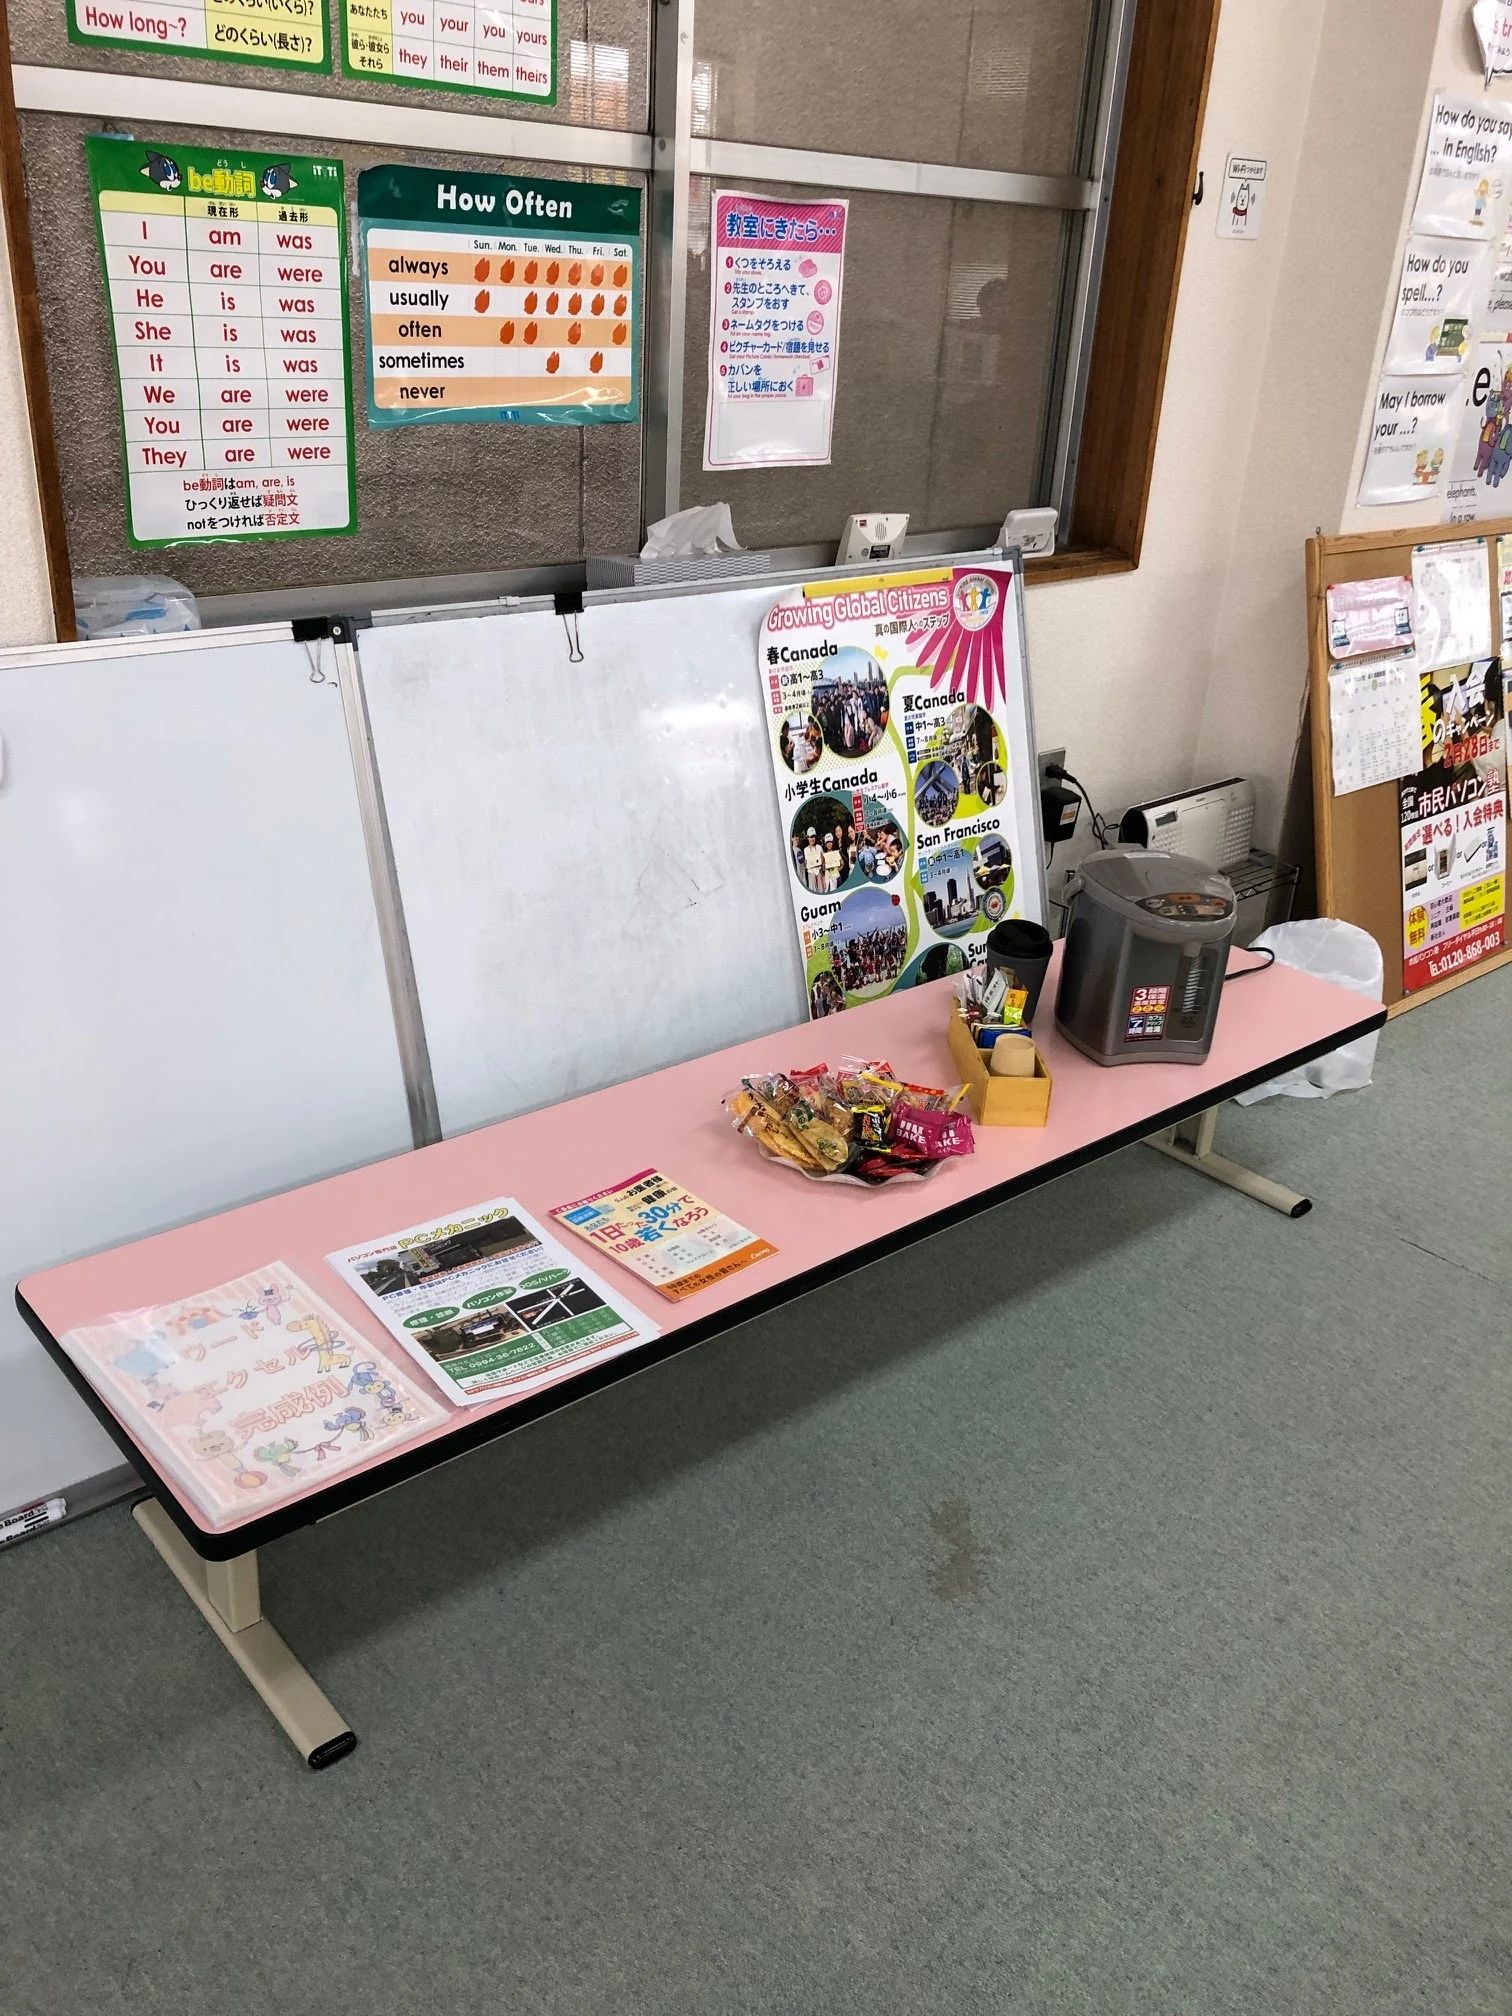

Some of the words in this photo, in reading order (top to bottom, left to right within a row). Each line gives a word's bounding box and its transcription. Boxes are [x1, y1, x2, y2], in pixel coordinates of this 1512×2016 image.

[85, 6, 124, 29] How
[350, 3, 388, 20] あなたたち
[400, 10, 425, 26] you
[440, 17, 469, 32] your
[483, 24, 506, 39] you
[516, 30, 548, 46] yours
[214, 24, 313, 54] どのくらい(長さ)?
[359, 56, 383, 69] それら
[399, 49, 428, 69] they
[440, 55, 469, 73] their
[477, 61, 510, 79] them
[515, 66, 548, 84] theirs
[1436, 105, 1460, 127] How
[1461, 110, 1476, 129] do
[1476, 116, 1497, 135] you
[1443, 137, 1454, 157] in
[1455, 140, 1498, 165] English?
[187, 167, 256, 198] be動詞
[207, 205, 239, 218] 現在形
[437, 184, 496, 213] How
[505, 189, 573, 219] Often
[278, 210, 309, 222] 過去形
[142, 221, 148, 240] I
[208, 229, 242, 246] am
[276, 233, 312, 250] was
[473, 239, 492, 250] Sun.
[498, 241, 517, 252] Mon.
[523, 243, 540, 253] Tue.
[545, 244, 562, 255] Wed.
[568, 245, 584, 256] Thu.
[592, 246, 605, 256] Fri.
[613, 247, 629, 258] Sat.
[128, 255, 166, 276] You
[210, 263, 242, 280] are
[277, 266, 323, 283] were
[388, 256, 449, 276] always
[735, 257, 791, 271] くつをそろえる
[1407, 253, 1431, 273] How
[1432, 254, 1447, 273] do
[1448, 259, 1469, 278] you
[136, 288, 164, 308] He
[220, 292, 236, 311] is
[278, 297, 315, 313] was
[389, 290, 449, 310] usually
[731, 297, 790, 310] スタンプをおす
[134, 321, 172, 341] She
[223, 322, 238, 342] is
[280, 327, 316, 344] was
[398, 321, 442, 337] often
[730, 319, 804, 331] ネームタグをつける
[150, 353, 163, 373] It
[225, 354, 241, 373] is
[282, 358, 318, 374] was
[378, 352, 464, 369] sometimes
[728, 364, 762, 376] カバンを
[143, 385, 176, 404] We
[220, 388, 252, 404] are
[285, 386, 329, 403] were
[399, 385, 446, 400] never
[728, 380, 793, 393] 正しい場所におく
[1379, 392, 1403, 412] May
[1404, 391, 1410, 407] I
[1410, 391, 1446, 407] borrow
[144, 416, 180, 435] You
[222, 418, 253, 434] are
[286, 416, 330, 432] were
[1374, 422, 1399, 441] your
[142, 447, 187, 468] They
[224, 447, 255, 463] are
[287, 444, 331, 460] were
[262, 477, 283, 488] are,
[286, 476, 295, 487] is
[185, 493, 298, 511] ひっくり返せば疑問文
[187, 513, 300, 530] notをつければ否定文
[767, 602, 834, 631] Growing
[835, 591, 884, 620] Global
[887, 586, 949, 615] Citizens
[767, 639, 838, 665] 春Canada
[902, 687, 965, 713] 夏Canada
[785, 768, 878, 801] 小学生Canada
[1418, 769, 1500, 818] 市民パソコン塾
[916, 833, 941, 849] San
[944, 818, 1000, 840] Francisco
[801, 901, 841, 922] Guam
[1135, 988, 1148, 1000] 3
[1131, 1019, 1143, 1028] 7
[896, 1128, 927, 1145] BAKE
[398, 1207, 509, 1249] PCメカニック
[589, 1194, 695, 1243] 1日たった30分で
[609, 1206, 709, 1254] 10歳若くなろう
[448, 1364, 468, 1374] TEL
[228, 1375, 349, 1440] 完成例
[4, 1510, 35, 1528] Board
